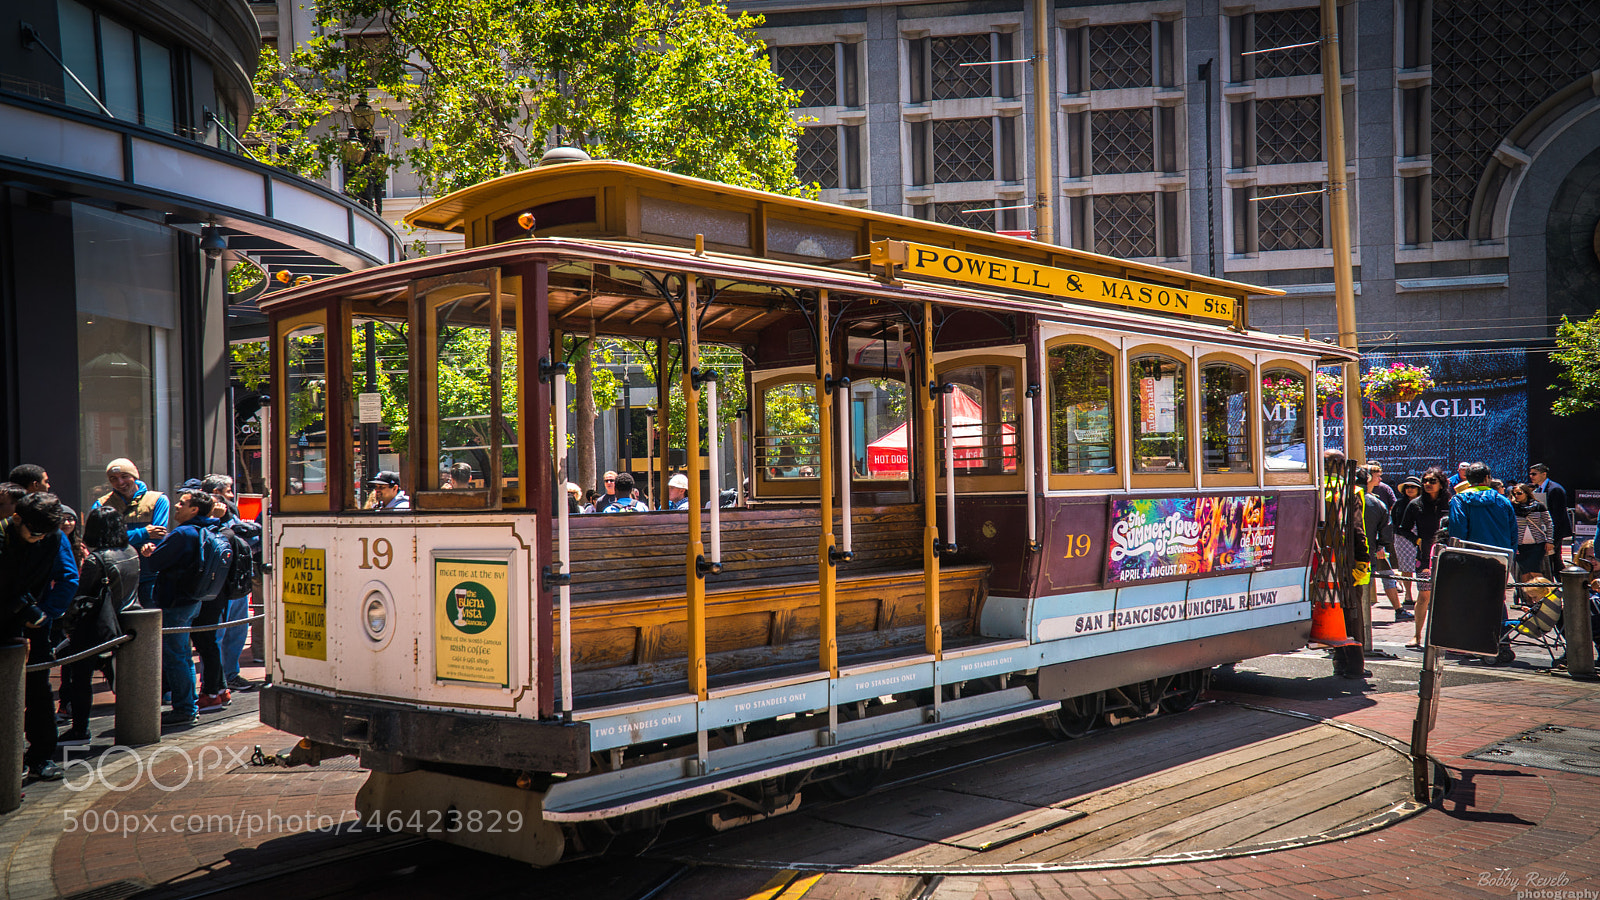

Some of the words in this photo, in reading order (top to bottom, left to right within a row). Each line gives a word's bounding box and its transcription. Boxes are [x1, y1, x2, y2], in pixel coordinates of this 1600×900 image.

[916, 249, 1050, 289] POWELL
[1066, 274, 1084, 293] &
[1101, 280, 1189, 309] MASON
[1204, 298, 1230, 315] Sts.
[1395, 398, 1486, 419] EAGLE
[874, 455, 889, 464] HOT
[891, 454, 909, 464] DOG
[1127, 511, 1146, 528] The
[1165, 512, 1200, 546] Love
[1063, 534, 1091, 559] 19
[1240, 534, 1250, 548] de
[1251, 533, 1274, 549] Young
[358, 537, 394, 570] 19
[285, 557, 322, 571] POWELL
[1120, 569, 1141, 582] APRIL
[1178, 564, 1187, 575] 20
[294, 572, 313, 581] AND
[283, 583, 322, 596] MARKET
[286, 610, 296, 625] BAY
[304, 612, 325, 628] TAYLOR
[1075, 615, 1103, 633] SAN
[1108, 604, 1177, 628] FRANCISCO
[1179, 597, 1235, 618] MUNICIPAL
[1239, 591, 1278, 609] RAILWAY
[289, 628, 322, 641] FISHERMANS
[974, 659, 999, 669] STANDEES
[1000, 656, 1013, 664] ONLY
[855, 681, 870, 690] TWO
[871, 676, 900, 688] STANDEES
[901, 673, 916, 683] ONLY
[735, 703, 751, 712] TWO
[753, 697, 787, 709] STANDEES
[789, 693, 807, 703] ONLY
[595, 727, 614, 738] TWO
[618, 719, 659, 734] STANDEES
[662, 714, 682, 726] ONLY
